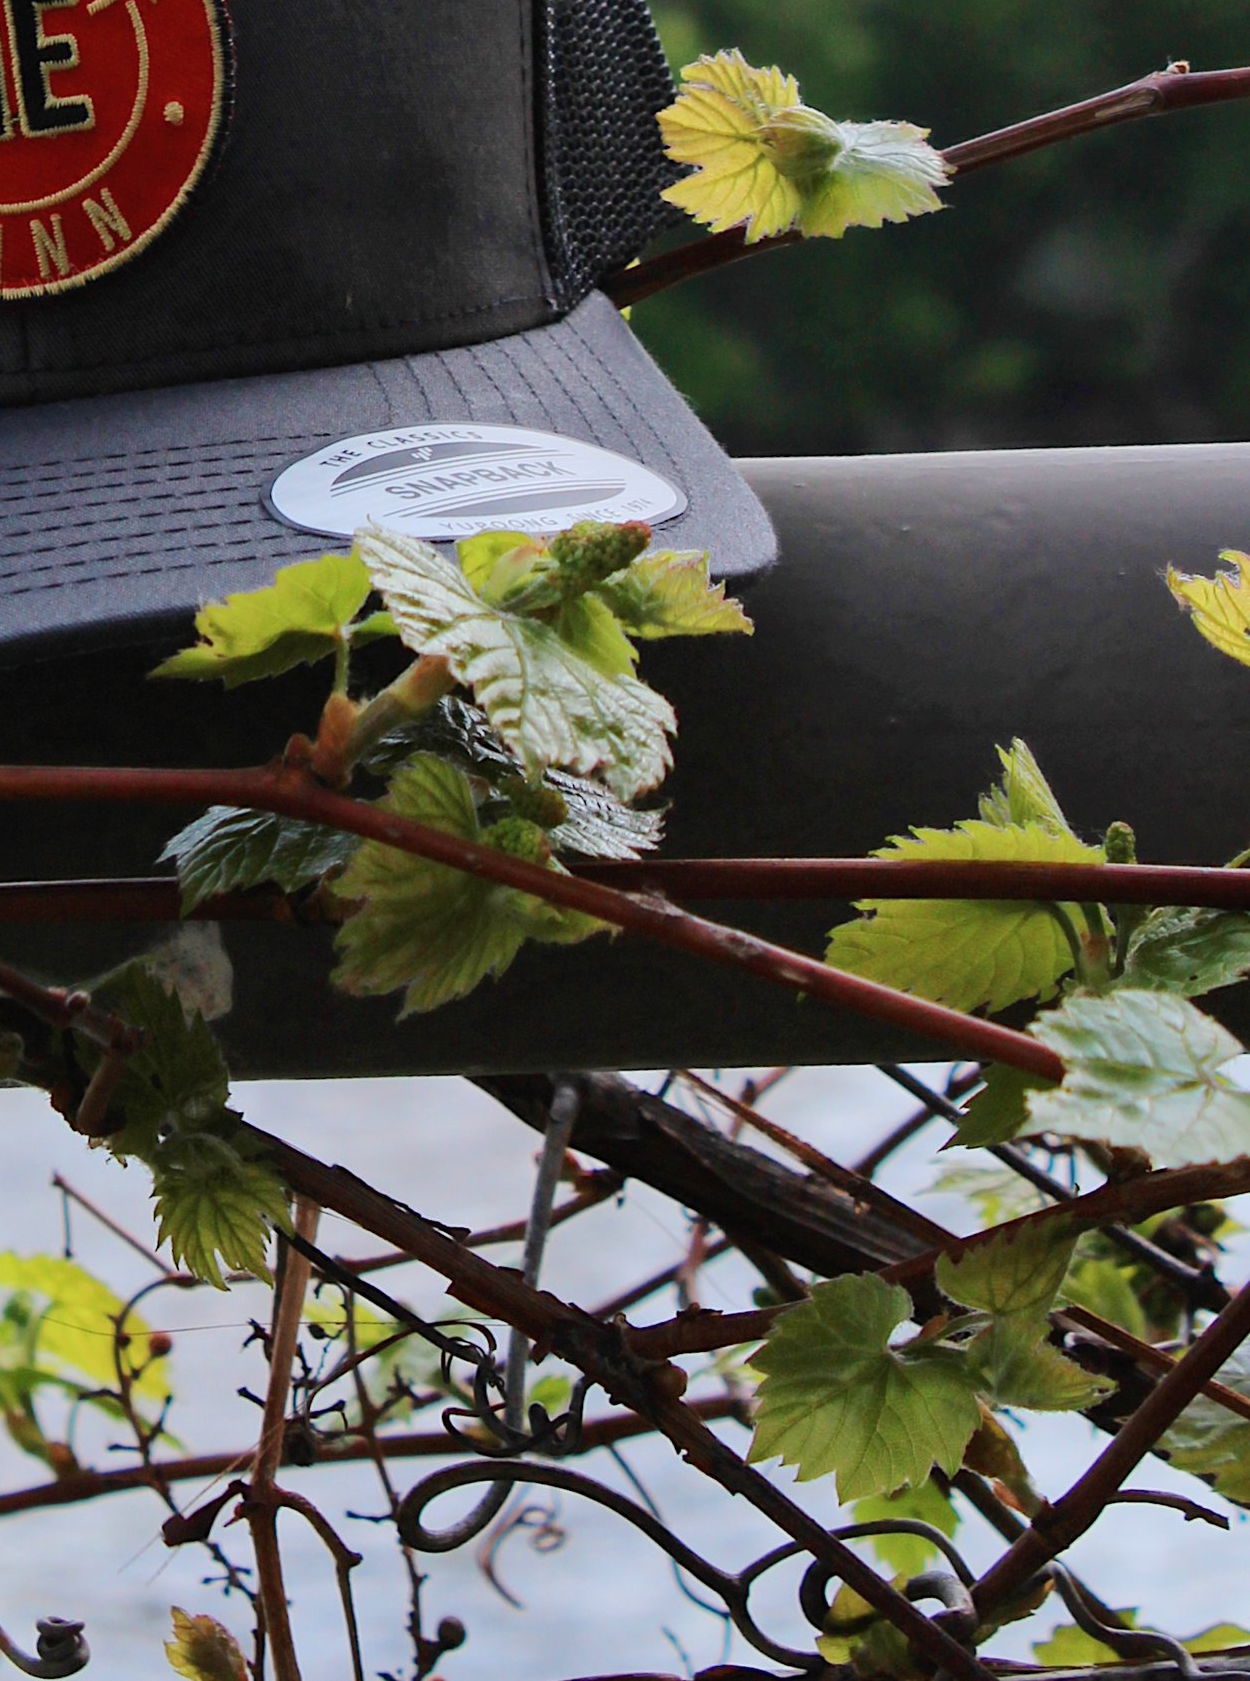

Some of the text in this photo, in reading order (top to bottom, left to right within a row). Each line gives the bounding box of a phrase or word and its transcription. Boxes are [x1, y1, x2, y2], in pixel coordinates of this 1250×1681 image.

[318, 430, 484, 468] THE CLASSICS
[384, 460, 577, 500] SNAPBACK
